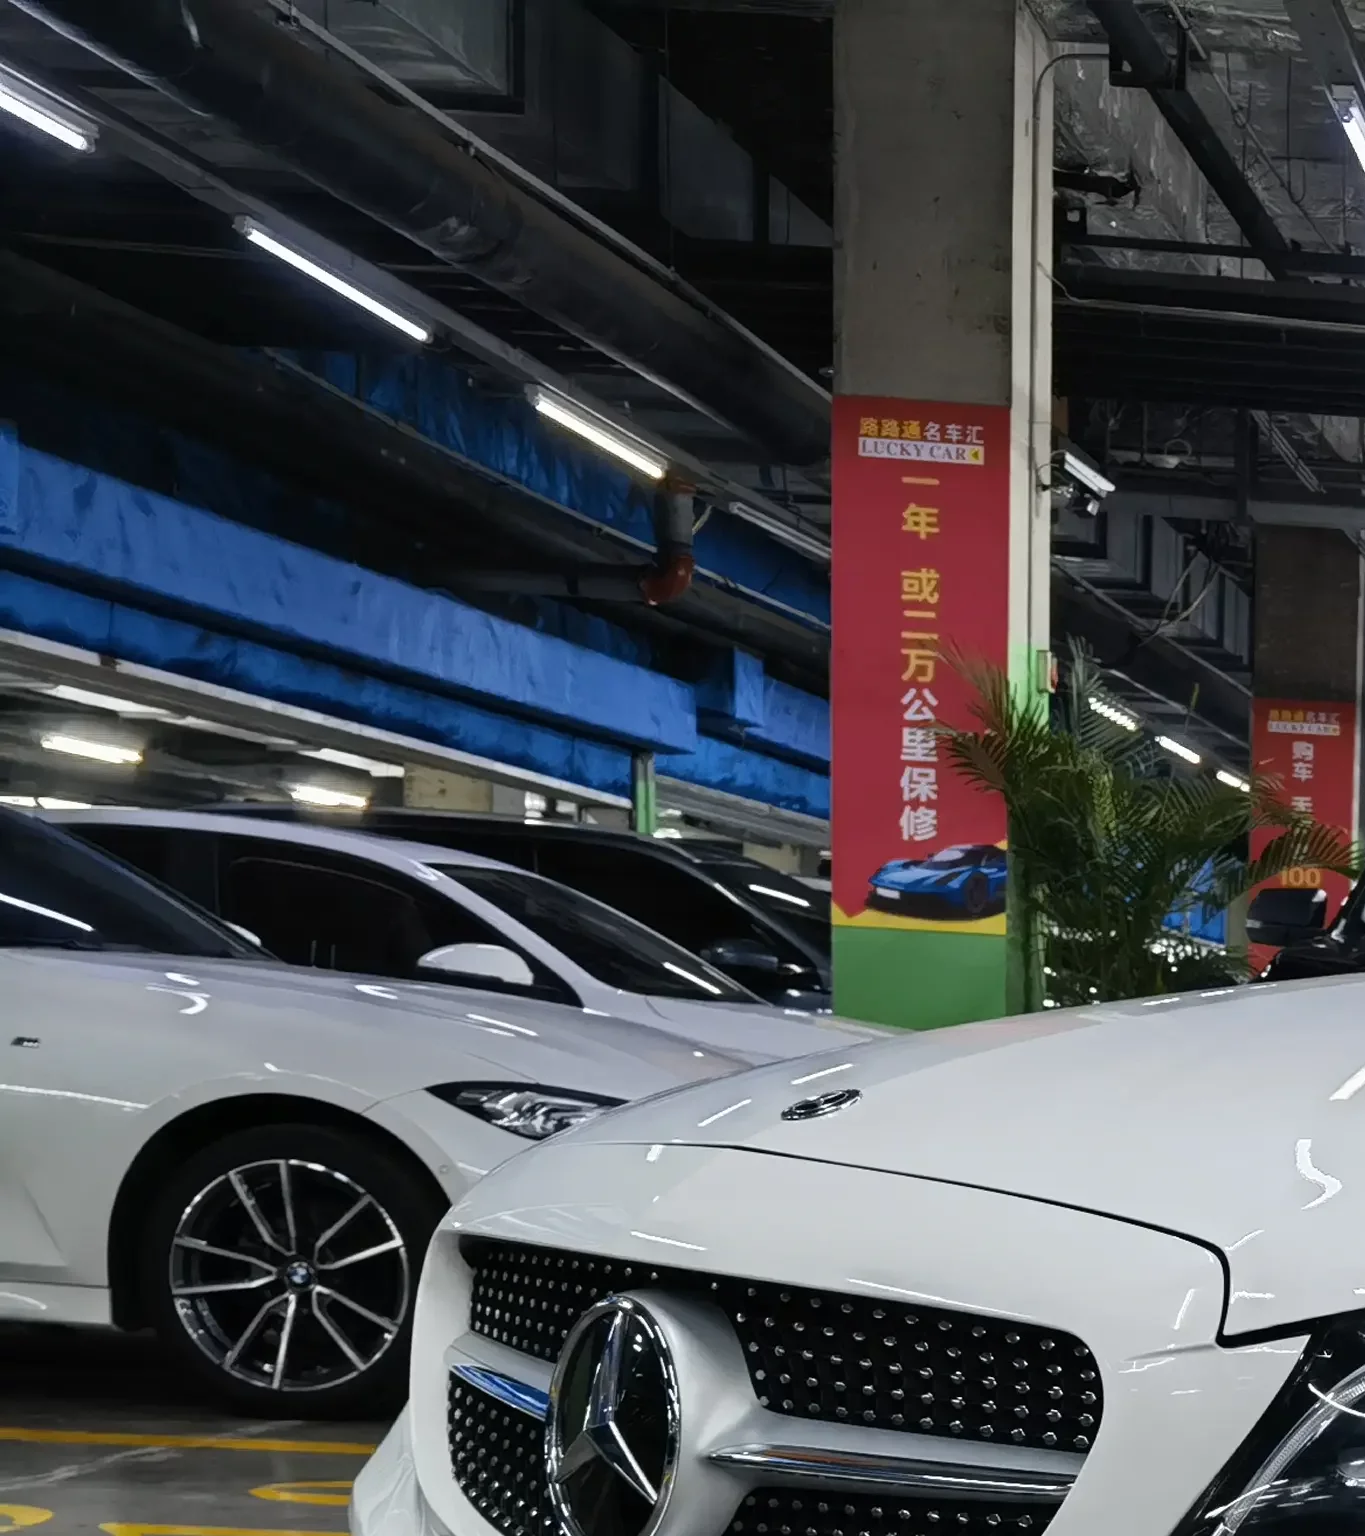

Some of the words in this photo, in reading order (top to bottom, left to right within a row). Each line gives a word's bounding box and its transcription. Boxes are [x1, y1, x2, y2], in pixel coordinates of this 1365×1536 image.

[859, 417, 985, 445] 路路通名车汇
[861, 440, 925, 459] LUCKY
[928, 445, 968, 462] CAR
